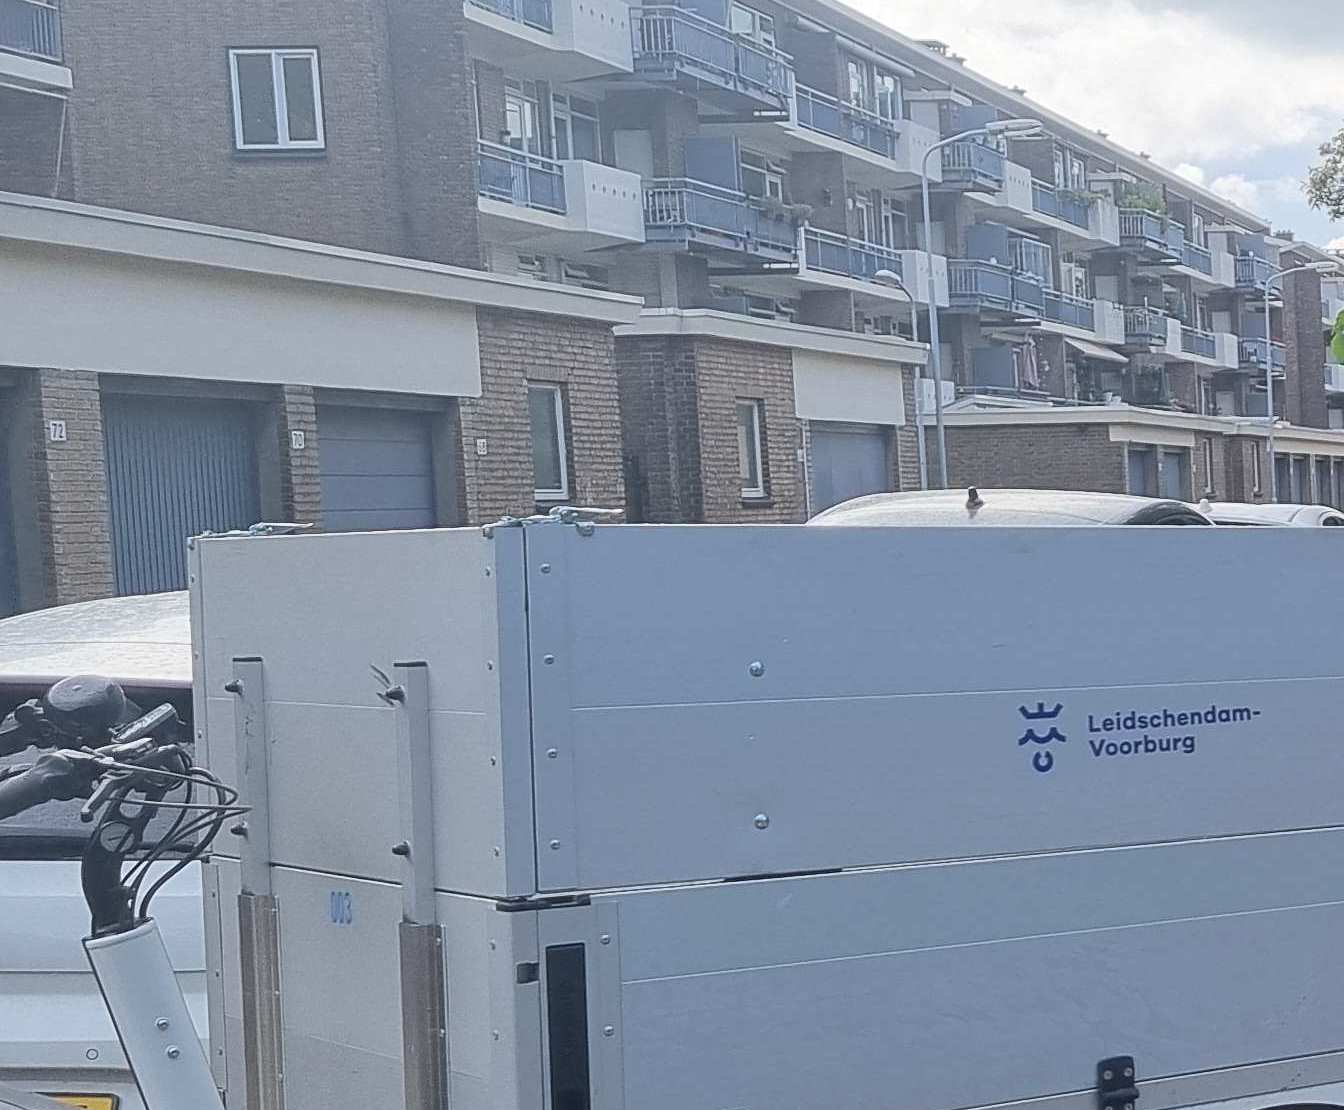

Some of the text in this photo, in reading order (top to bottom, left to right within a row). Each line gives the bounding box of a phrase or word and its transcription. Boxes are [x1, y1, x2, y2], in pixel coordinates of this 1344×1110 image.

[52, 423, 64, 439] 72
[1088, 705, 1262, 733] Leidschendam-
[1089, 725, 1196, 757] Voorburg
[330, 891, 352, 924] 003
